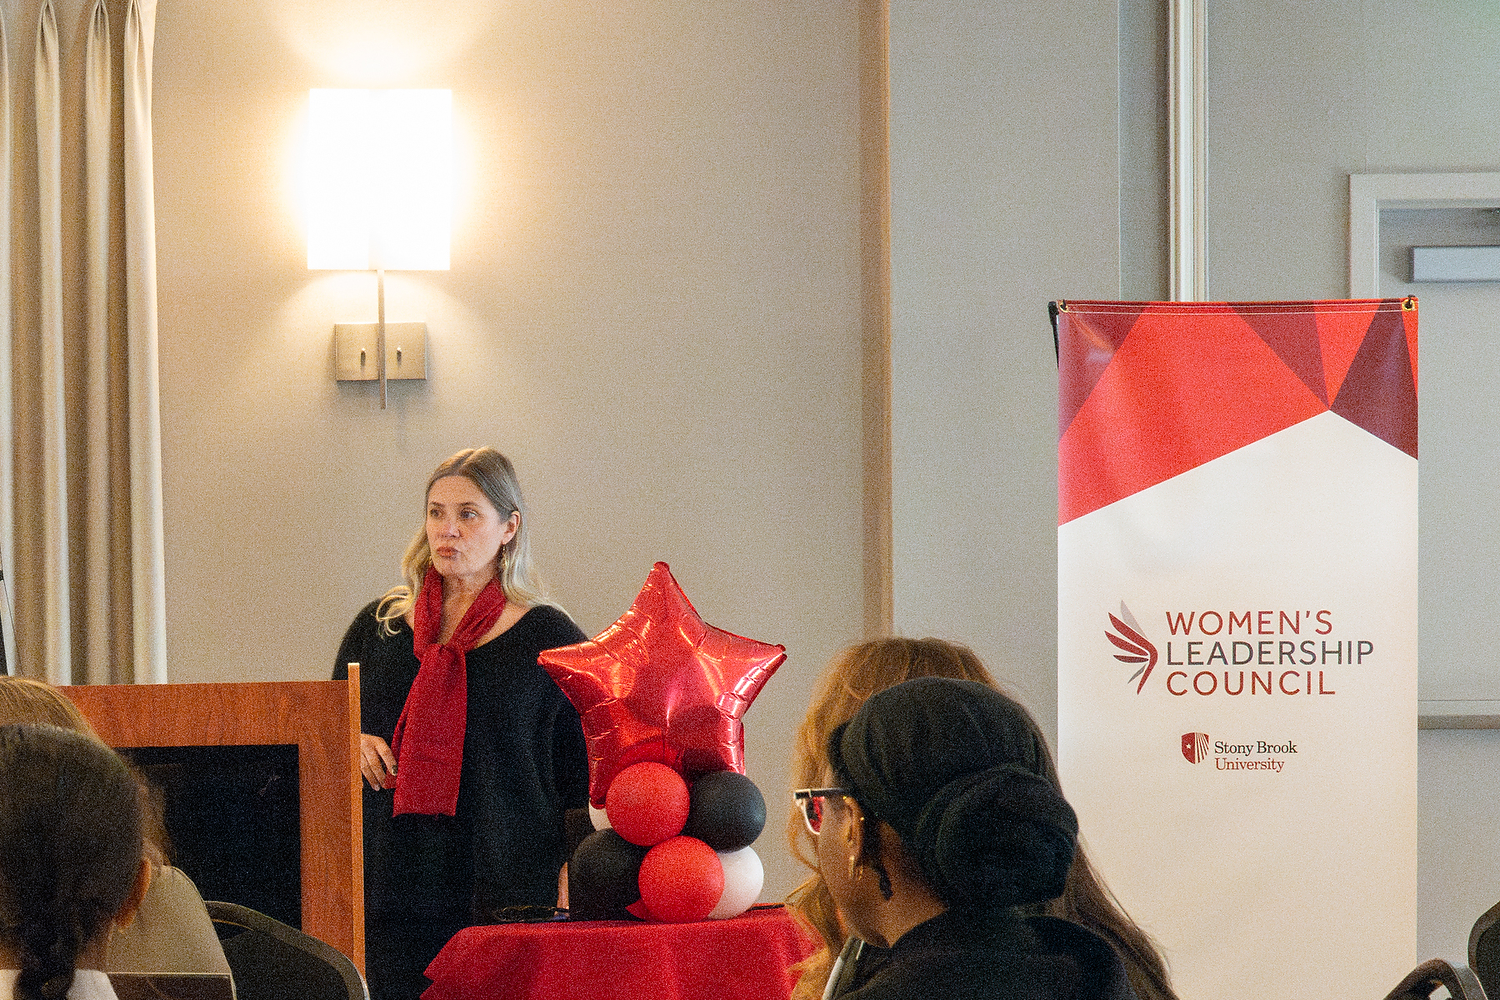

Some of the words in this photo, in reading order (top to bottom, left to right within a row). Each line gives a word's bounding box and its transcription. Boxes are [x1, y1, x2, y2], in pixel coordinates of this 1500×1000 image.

[1165, 609, 1334, 637] WOMEN’S
[1165, 639, 1376, 666] LEADERSHIP
[1165, 669, 1337, 697] COUNCIL
[1214, 740, 1254, 757] Stony
[1257, 740, 1298, 754] Brook
[1214, 757, 1285, 773] University
